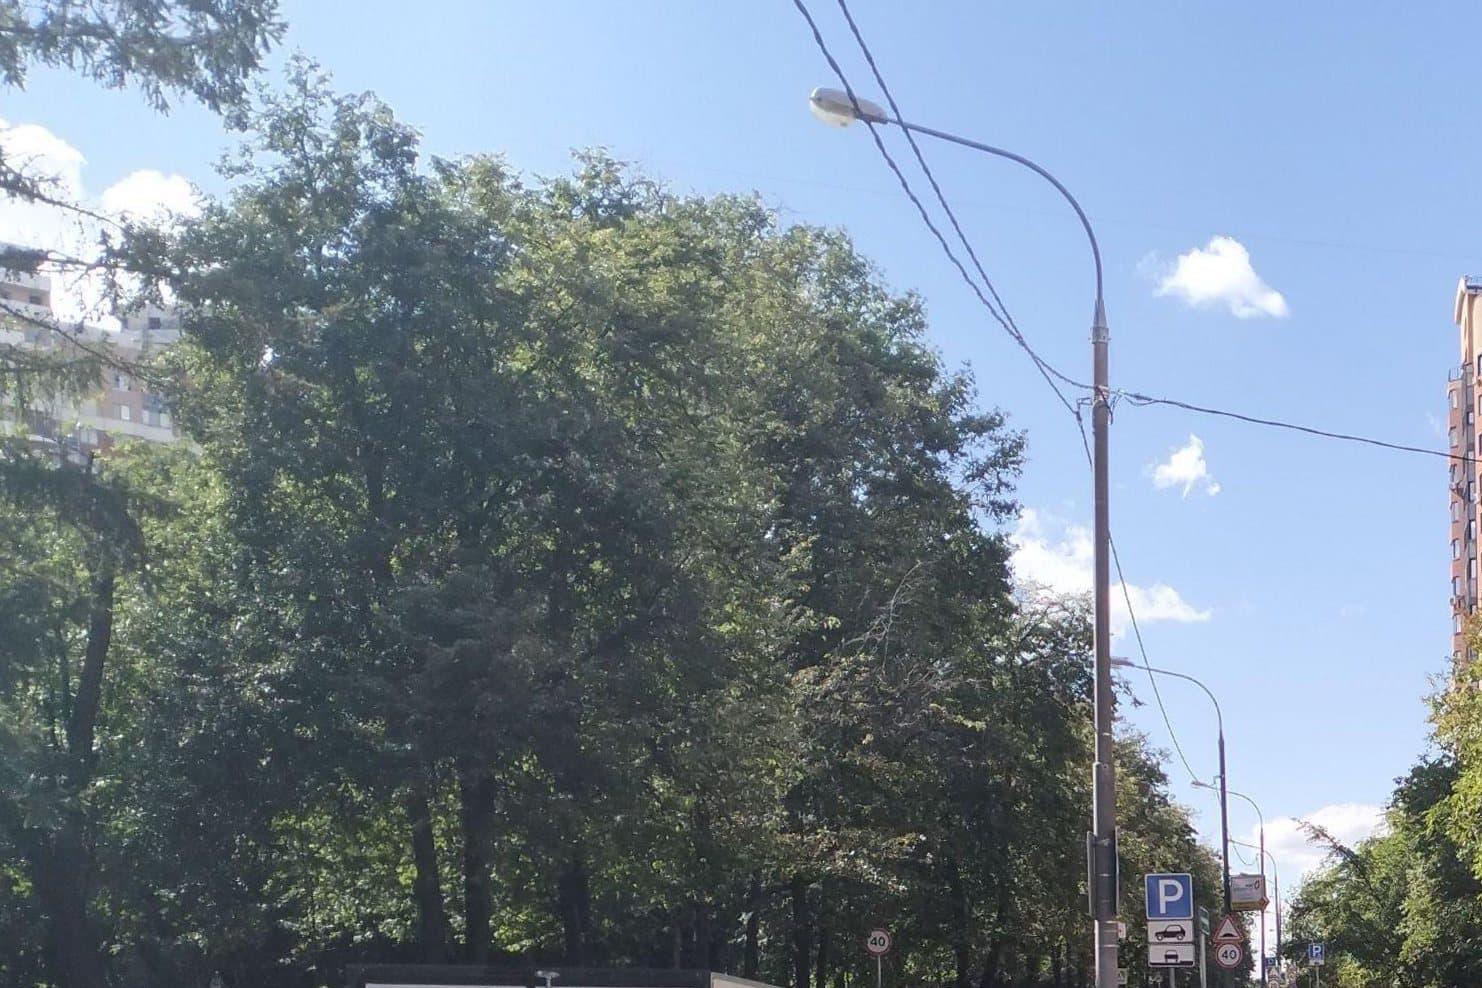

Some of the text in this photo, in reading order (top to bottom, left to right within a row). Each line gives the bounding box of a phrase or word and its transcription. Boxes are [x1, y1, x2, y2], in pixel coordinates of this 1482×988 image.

[1158, 879, 1184, 914] P
[870, 936, 886, 947] 40
[1221, 949, 1237, 959] 40
